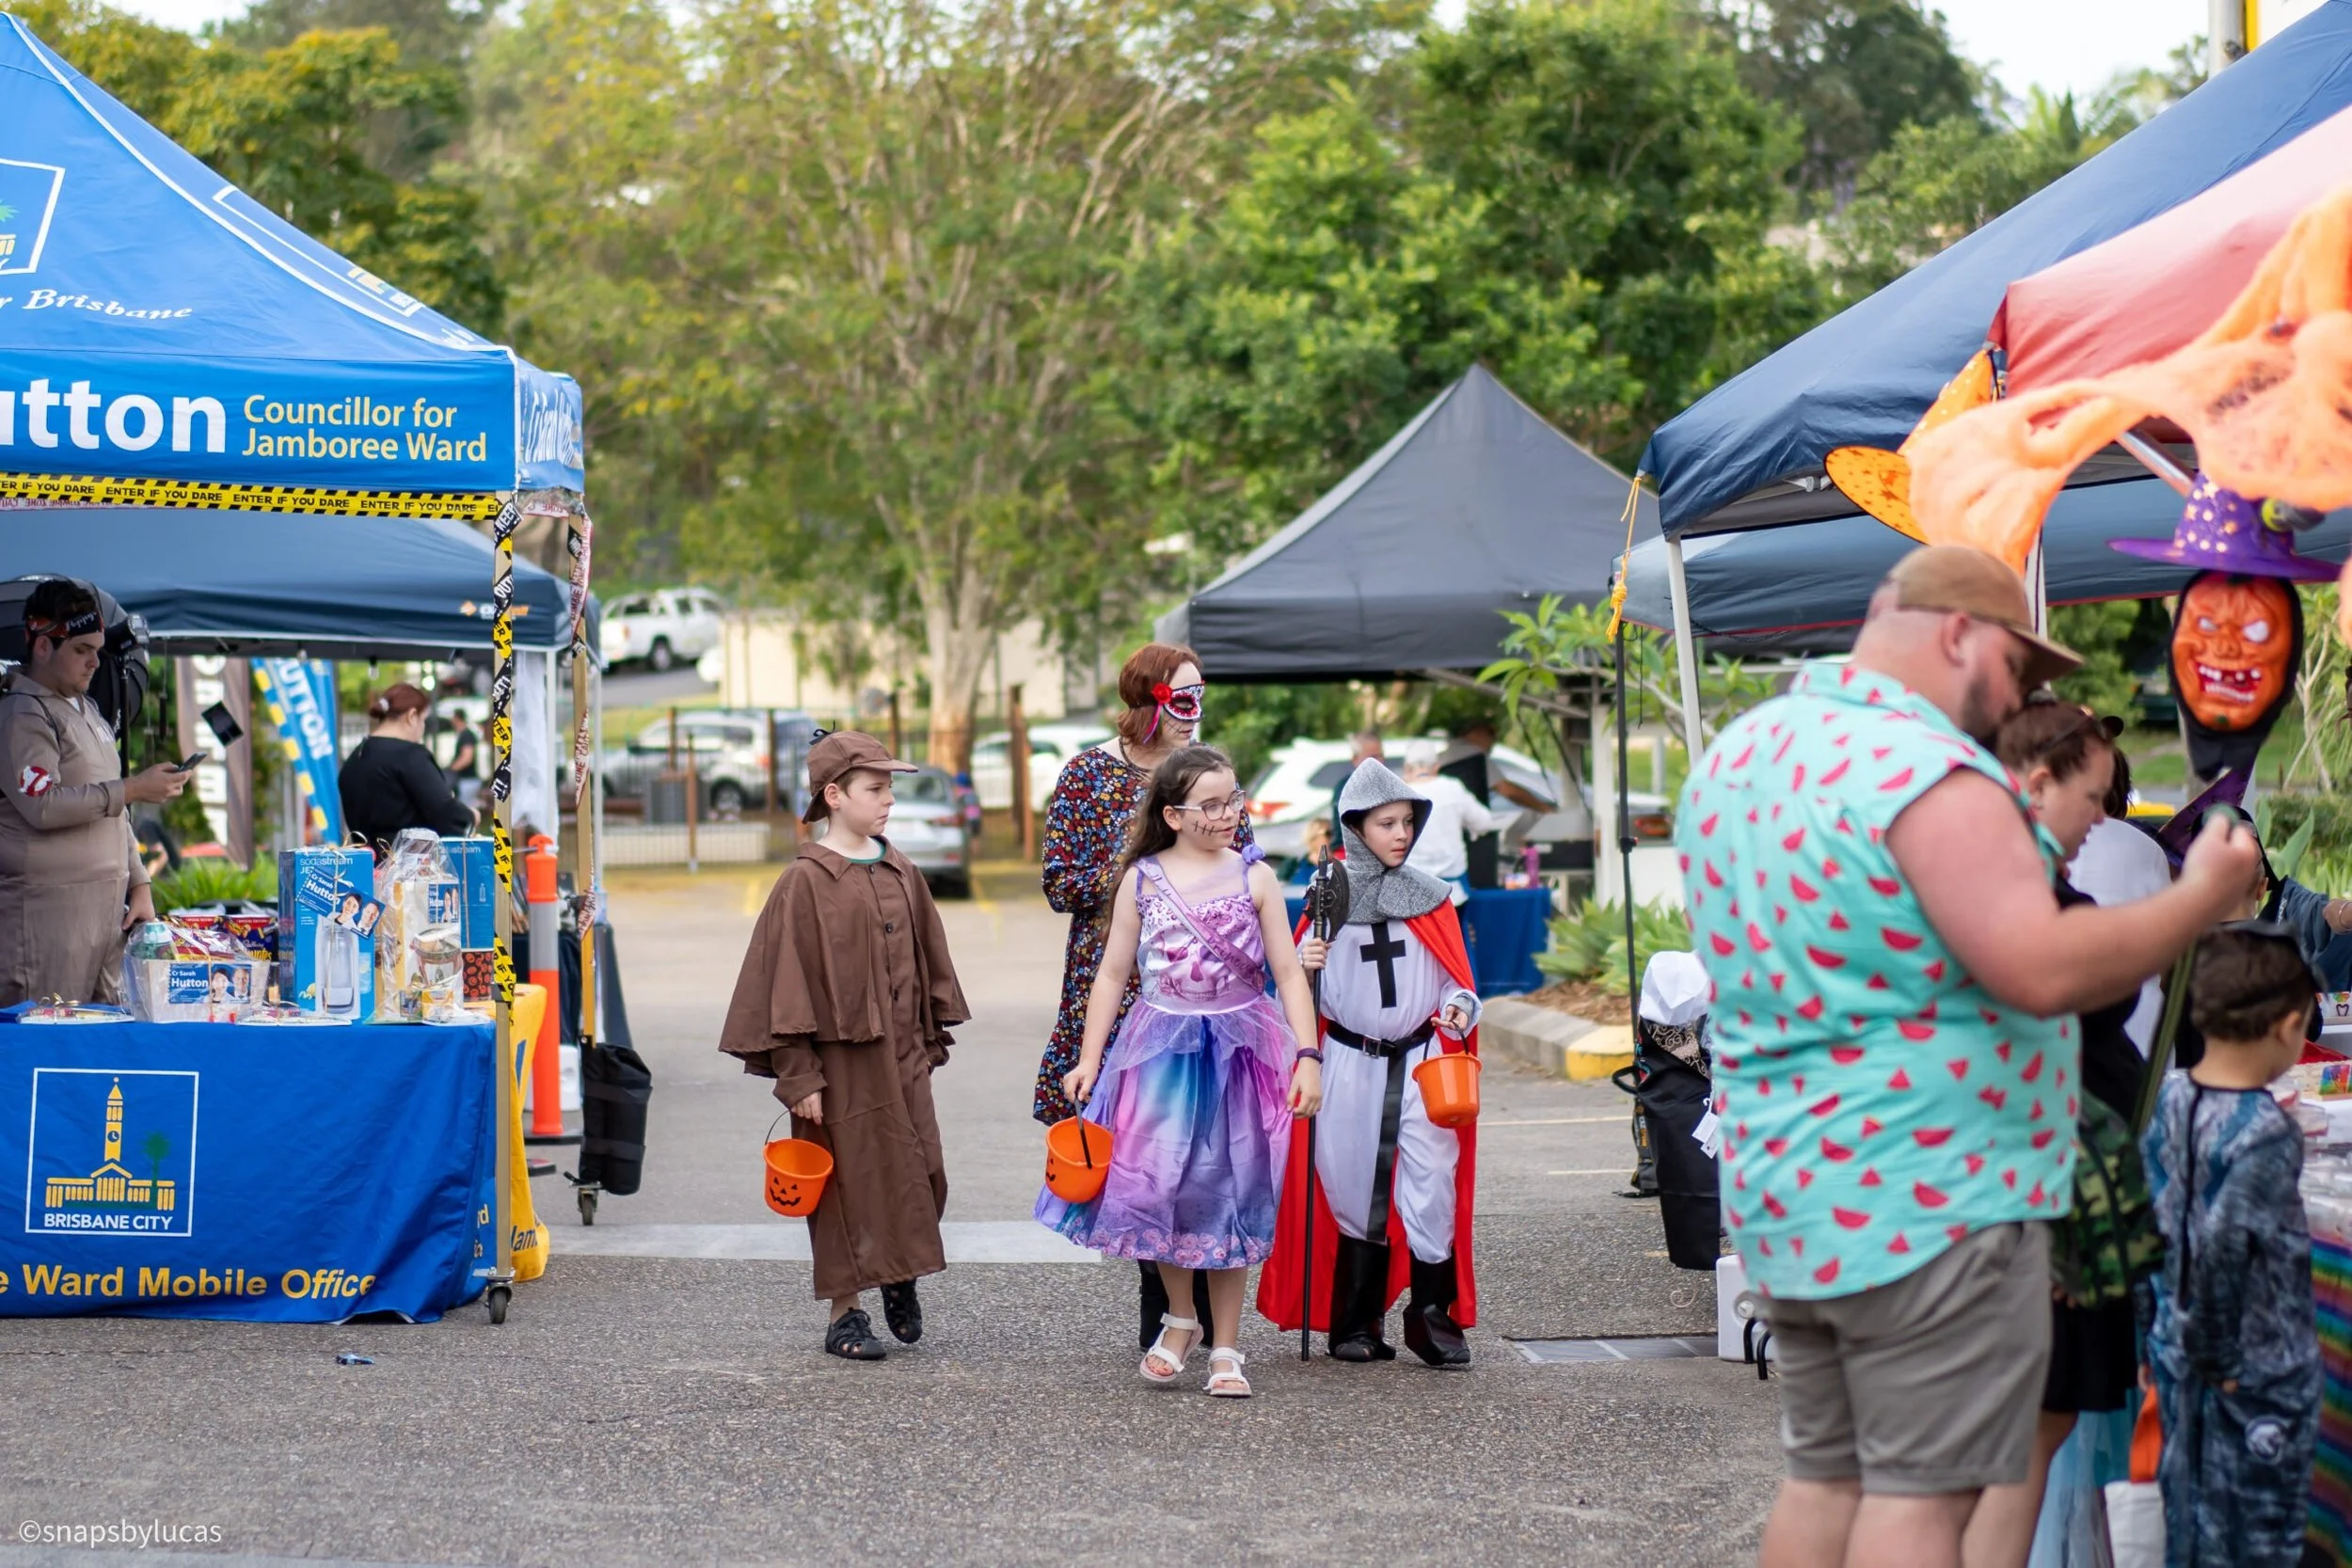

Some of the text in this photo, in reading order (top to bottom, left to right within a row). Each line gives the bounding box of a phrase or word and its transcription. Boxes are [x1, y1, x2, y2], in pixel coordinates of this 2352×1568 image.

[23, 288, 193, 320] Brisbane
[244, 393, 457, 428] Councillor for
[242, 427, 487, 462] Jamboree Ward
[22, 482, 33, 490] IF
[37, 482, 60, 492] YOU
[64, 484, 95, 494] DARE
[105, 486, 145, 498] ENTER
[150, 488, 160, 498] IF
[165, 489, 187, 499] YOU
[192, 491, 223, 501] DARE
[233, 494, 272, 504] ENTER
[278, 495, 287, 504] IF
[292, 496, 315, 506] YOU
[319, 499, 350, 508] DARE
[360, 499, 400, 511] ENTER
[405, 501, 415, 511] IF
[419, 501, 442, 512] YOU
[447, 502, 477, 513] DARE
[275, 657, 333, 760] UTTON
[306, 879, 341, 905] Hutton
[171, 977, 209, 989] Hutton
[43, 1212, 173, 1230] BRISBANE CITY
[22, 1263, 124, 1296] Ward
[138, 1267, 267, 1297] Mobile
[281, 1268, 376, 1300] Office
